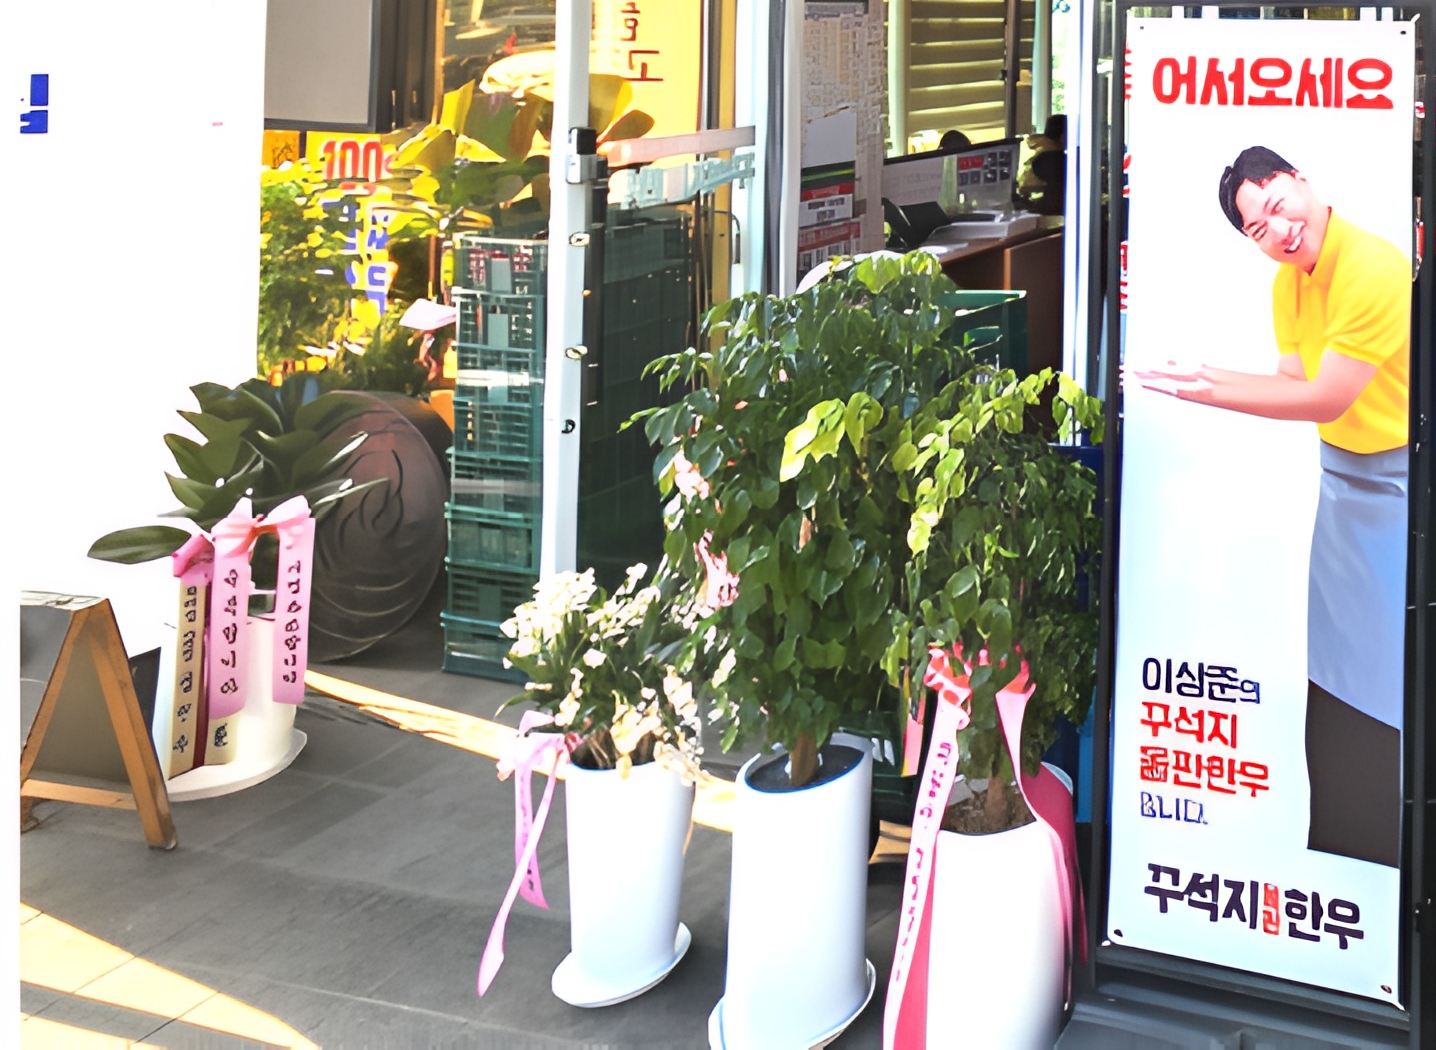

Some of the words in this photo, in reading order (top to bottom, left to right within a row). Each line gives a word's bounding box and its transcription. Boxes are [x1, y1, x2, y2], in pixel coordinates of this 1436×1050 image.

[1152, 56, 1393, 110] 어서오세요
[1140, 702, 1237, 748] 꾸석지
[1144, 863, 1260, 929] 꾸석지
[1285, 888, 1364, 950] 한우
